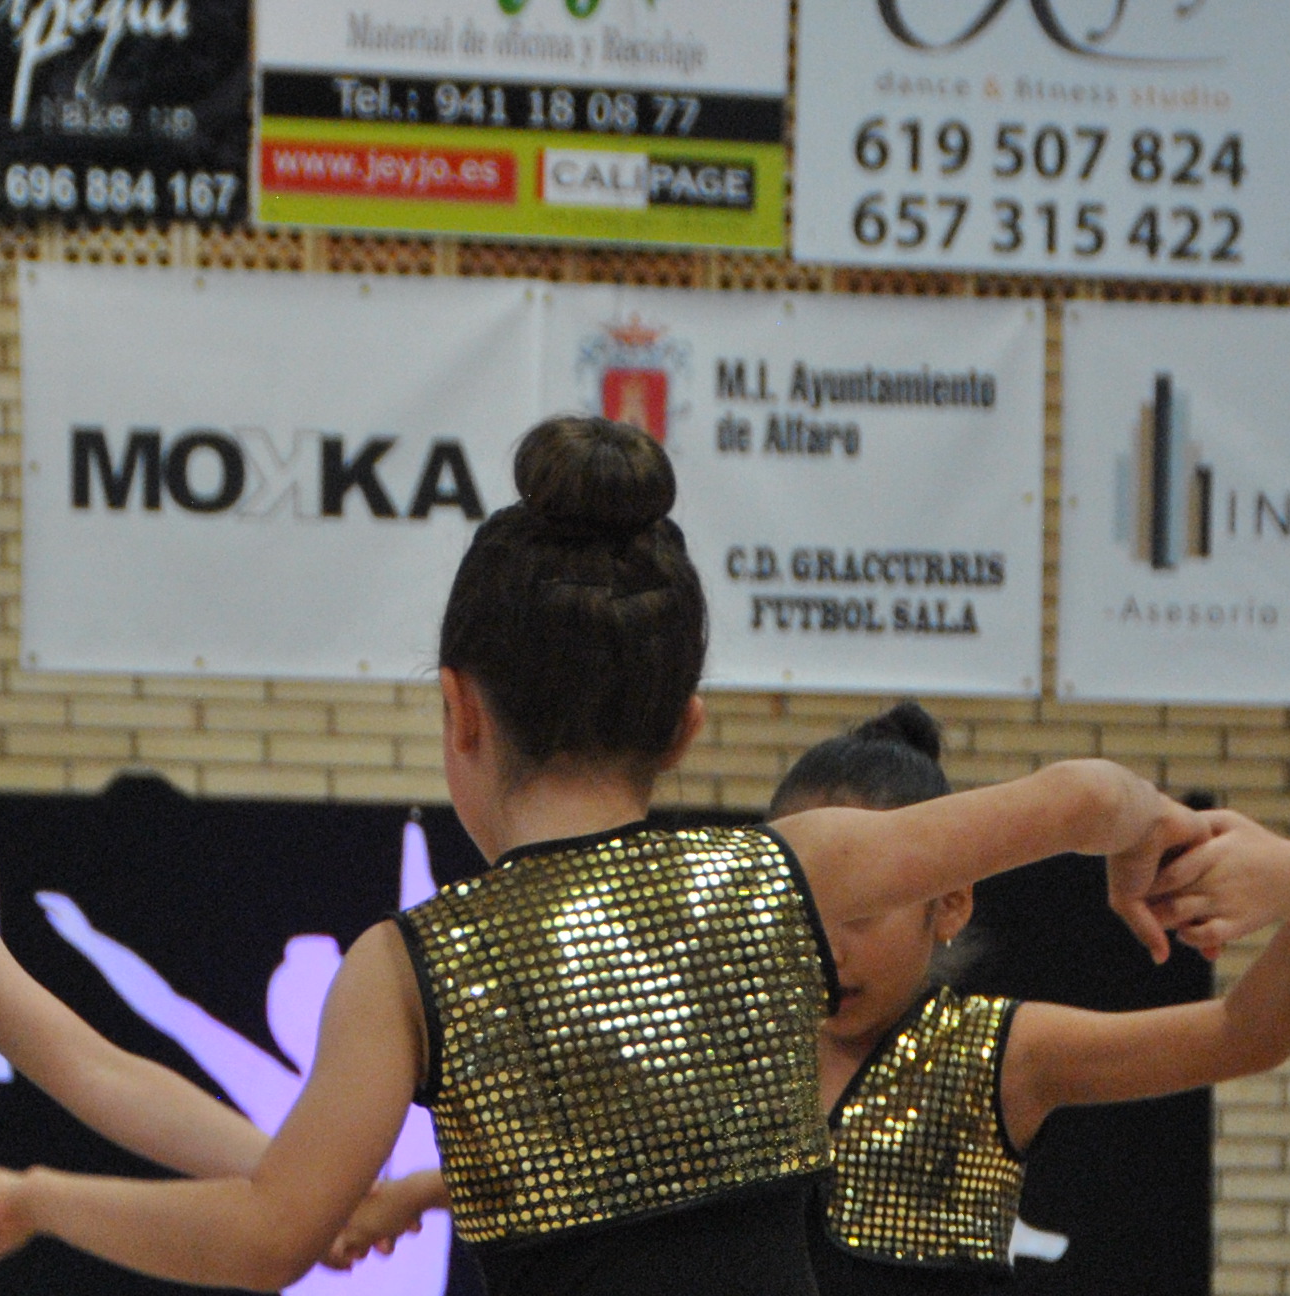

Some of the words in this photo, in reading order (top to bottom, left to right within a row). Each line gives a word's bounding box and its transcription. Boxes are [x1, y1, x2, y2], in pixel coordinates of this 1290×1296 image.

[333, 76, 419, 121] Tel.:
[435, 82, 507, 124] 941
[529, 88, 575, 129] 18
[586, 92, 638, 133] 08
[652, 96, 701, 136] 77
[875, 69, 971, 98] dance
[1129, 84, 1231, 112] studio
[272, 147, 500, 190] www.jeyjo.es
[854, 117, 973, 174] 619
[994, 124, 1108, 180] 507
[1129, 129, 1245, 187] 824
[5, 164, 78, 210] 696
[86, 167, 157, 212] 884
[168, 171, 238, 218] 167
[852, 192, 968, 250] 657
[992, 198, 1107, 257] 315
[1127, 204, 1244, 263] 422
[715, 358, 777, 402] M.I.
[788, 360, 998, 409] Ayuntamiento
[715, 413, 752, 454] de
[764, 414, 861, 458] Alfaro
[791, 547, 1005, 586] GRACCURRIS
[751, 593, 884, 633] FUTBOL
[891, 600, 979, 635] SALA
